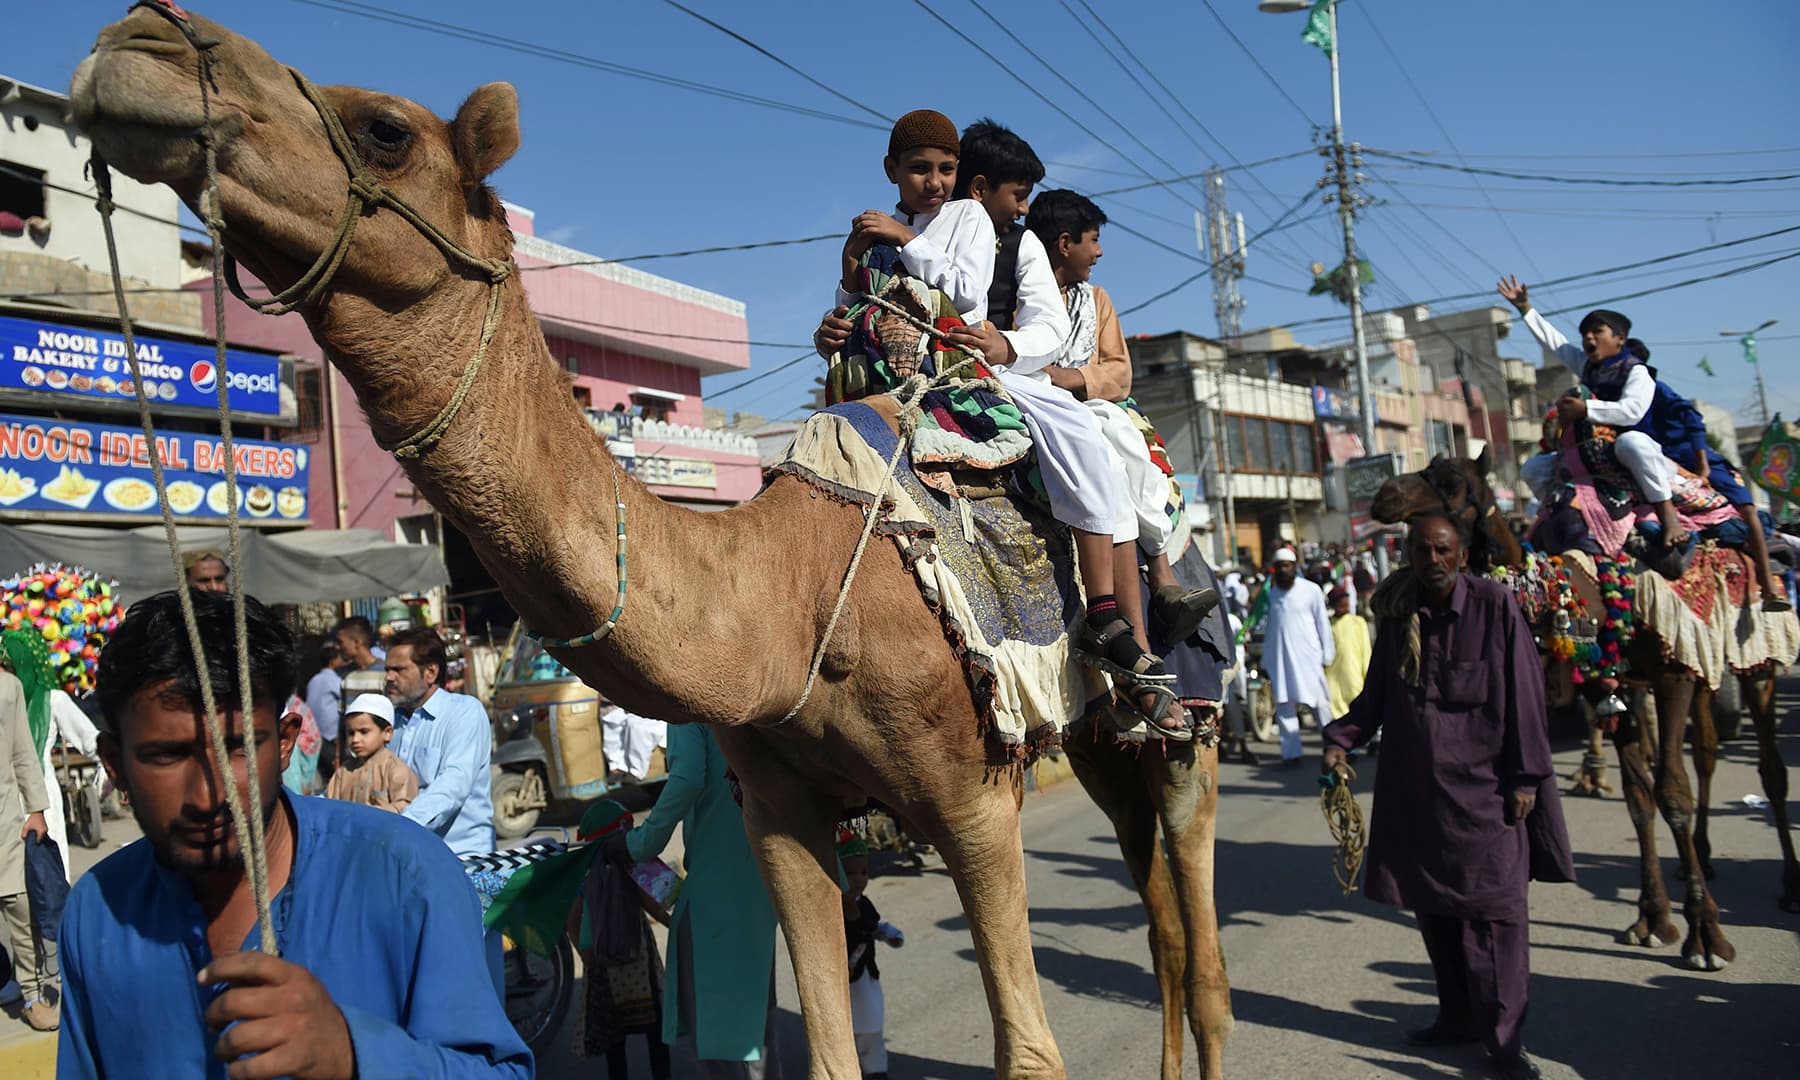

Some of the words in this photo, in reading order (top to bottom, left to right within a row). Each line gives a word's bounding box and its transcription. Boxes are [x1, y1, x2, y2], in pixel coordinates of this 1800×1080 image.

[38, 329, 99, 355] NOOR
[13, 345, 98, 370] BAKERY
[102, 357, 119, 372] &
[224, 370, 278, 395] pepsi
[0, 422, 93, 465] NOOR
[100, 431, 189, 471] IDEAL
[194, 440, 296, 479] BAKERS
